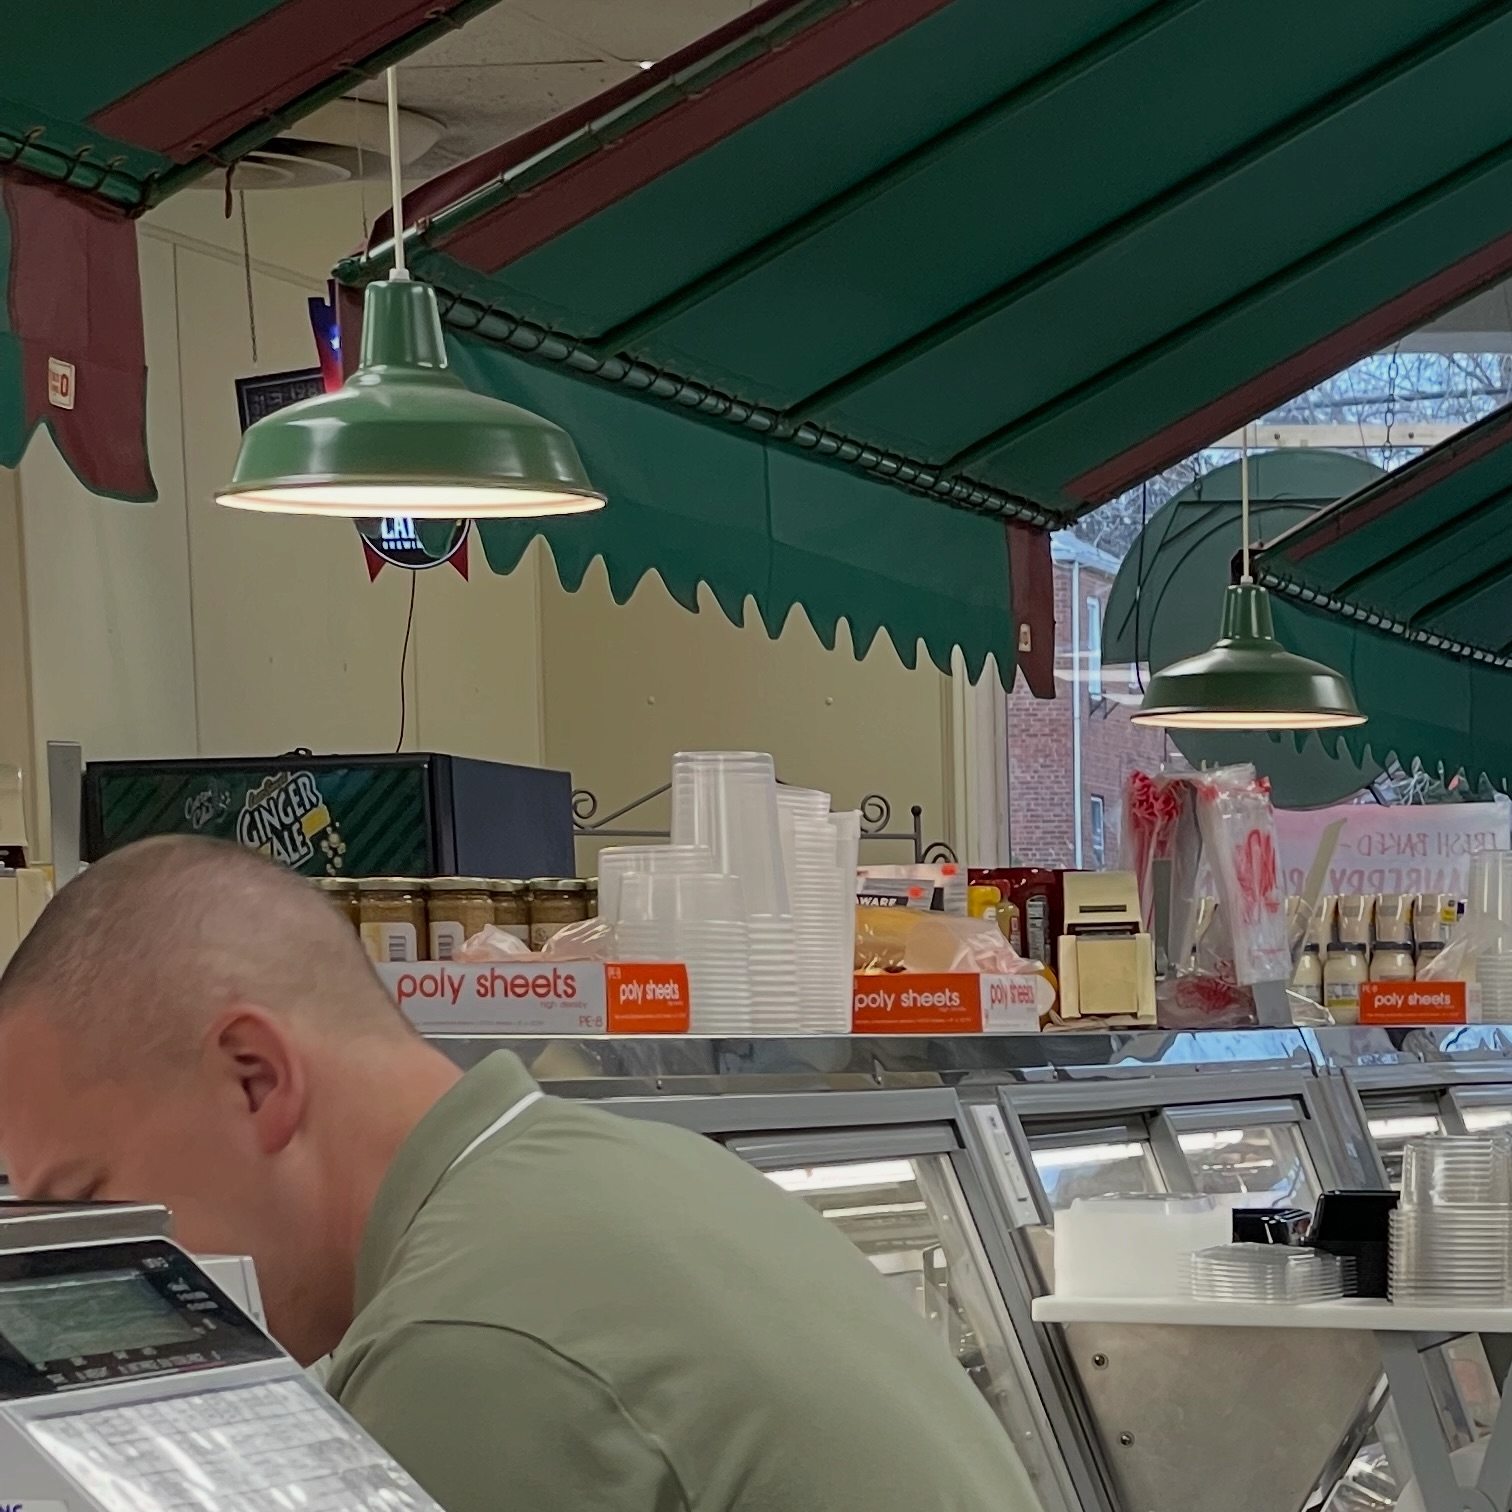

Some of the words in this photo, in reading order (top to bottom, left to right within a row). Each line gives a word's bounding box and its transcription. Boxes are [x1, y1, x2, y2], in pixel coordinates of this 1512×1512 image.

[242, 775, 318, 849] GINGER
[270, 822, 309, 865] ALE
[397, 967, 466, 1005] poly
[476, 967, 577, 999] sheets
[620, 979, 644, 1005] poly
[645, 978, 680, 1000] sheets
[855, 989, 896, 1012] poly
[900, 988, 961, 1007] sheets
[990, 982, 1008, 1010] poly
[1010, 981, 1035, 1005] sheets
[1374, 991, 1405, 1009] poly
[1407, 991, 1451, 1006] sheets
